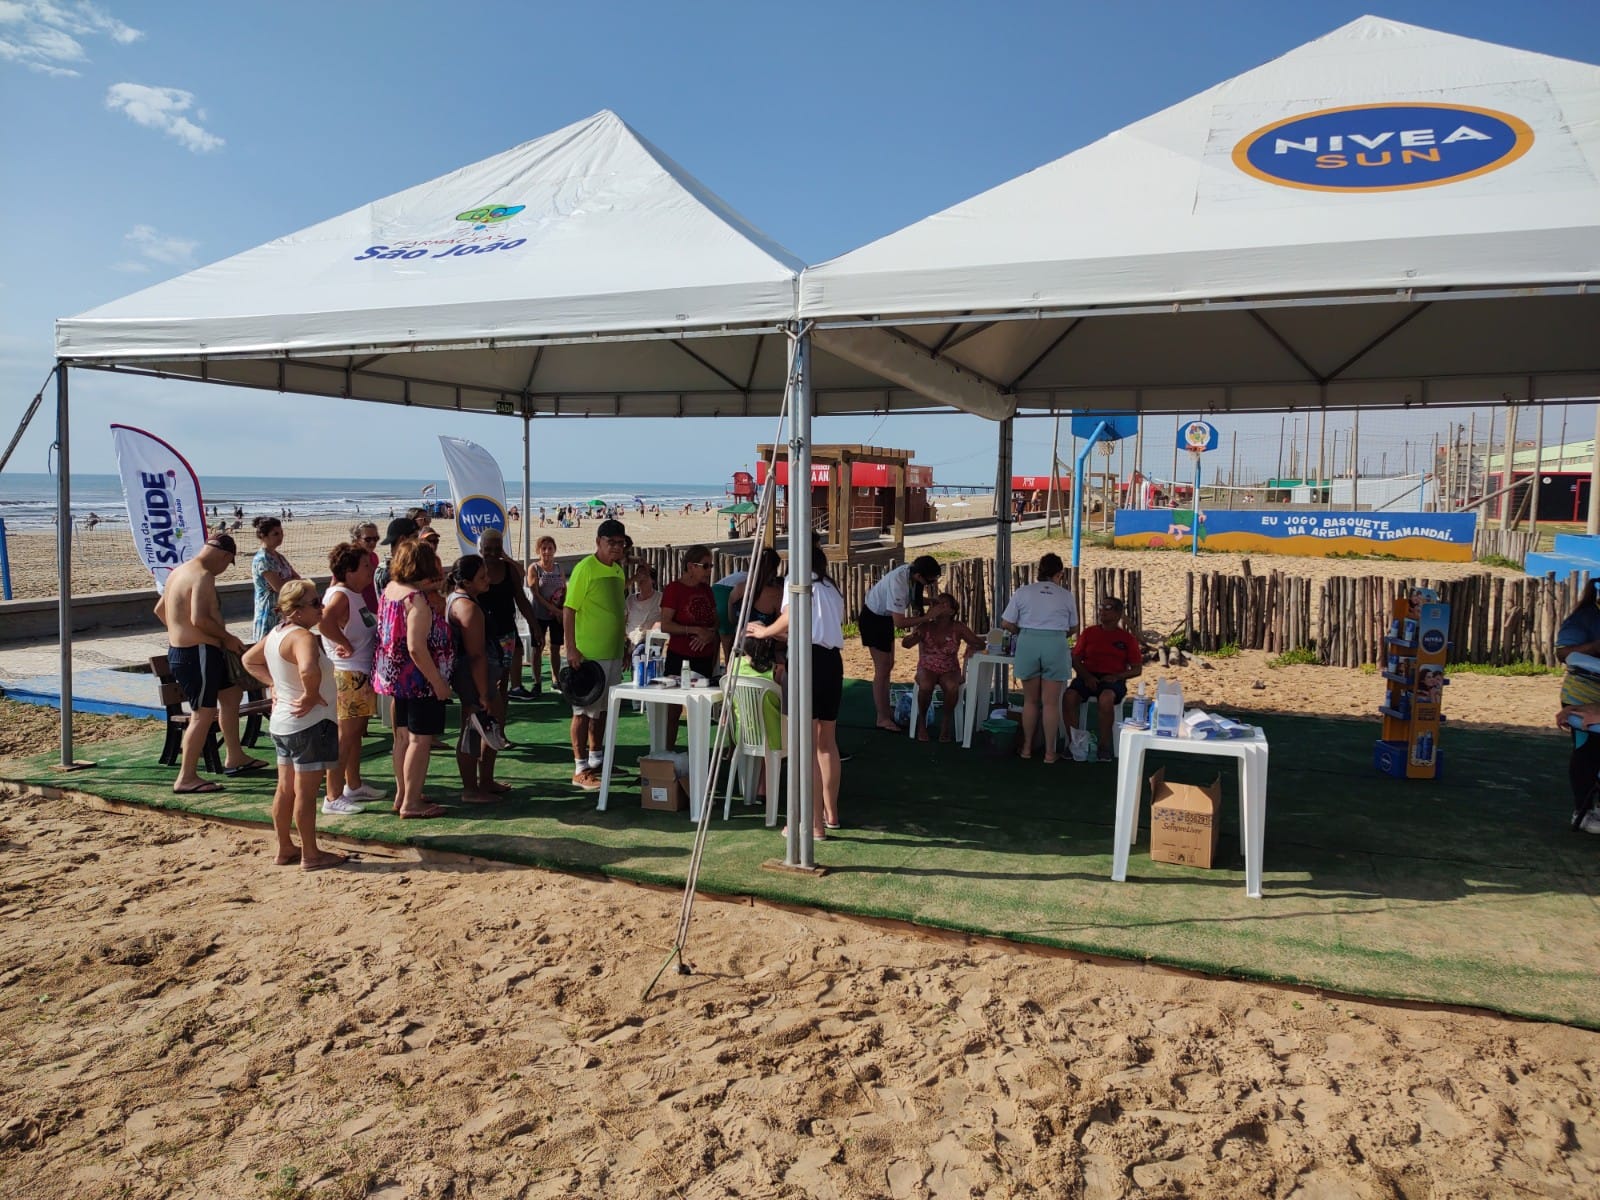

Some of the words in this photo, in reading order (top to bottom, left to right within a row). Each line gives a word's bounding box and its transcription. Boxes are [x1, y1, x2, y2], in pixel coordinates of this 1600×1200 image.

[1274, 125, 1493, 154] NIVEA
[1314, 148, 1441, 170] SUN
[354, 245, 429, 260] São
[431, 238, 527, 259] João
[140, 522, 149, 535] da
[141, 472, 178, 564] SAÚDE
[462, 513, 501, 525] NIVEA
[1261, 516, 1278, 526] EU
[1283, 516, 1318, 526] JOGO
[1323, 518, 1390, 530] BASQUETE
[1287, 526, 1306, 536] NA
[1310, 526, 1348, 538] AREIA
[1353, 527, 1373, 538] EM
[144, 537, 155, 564] Trilha
